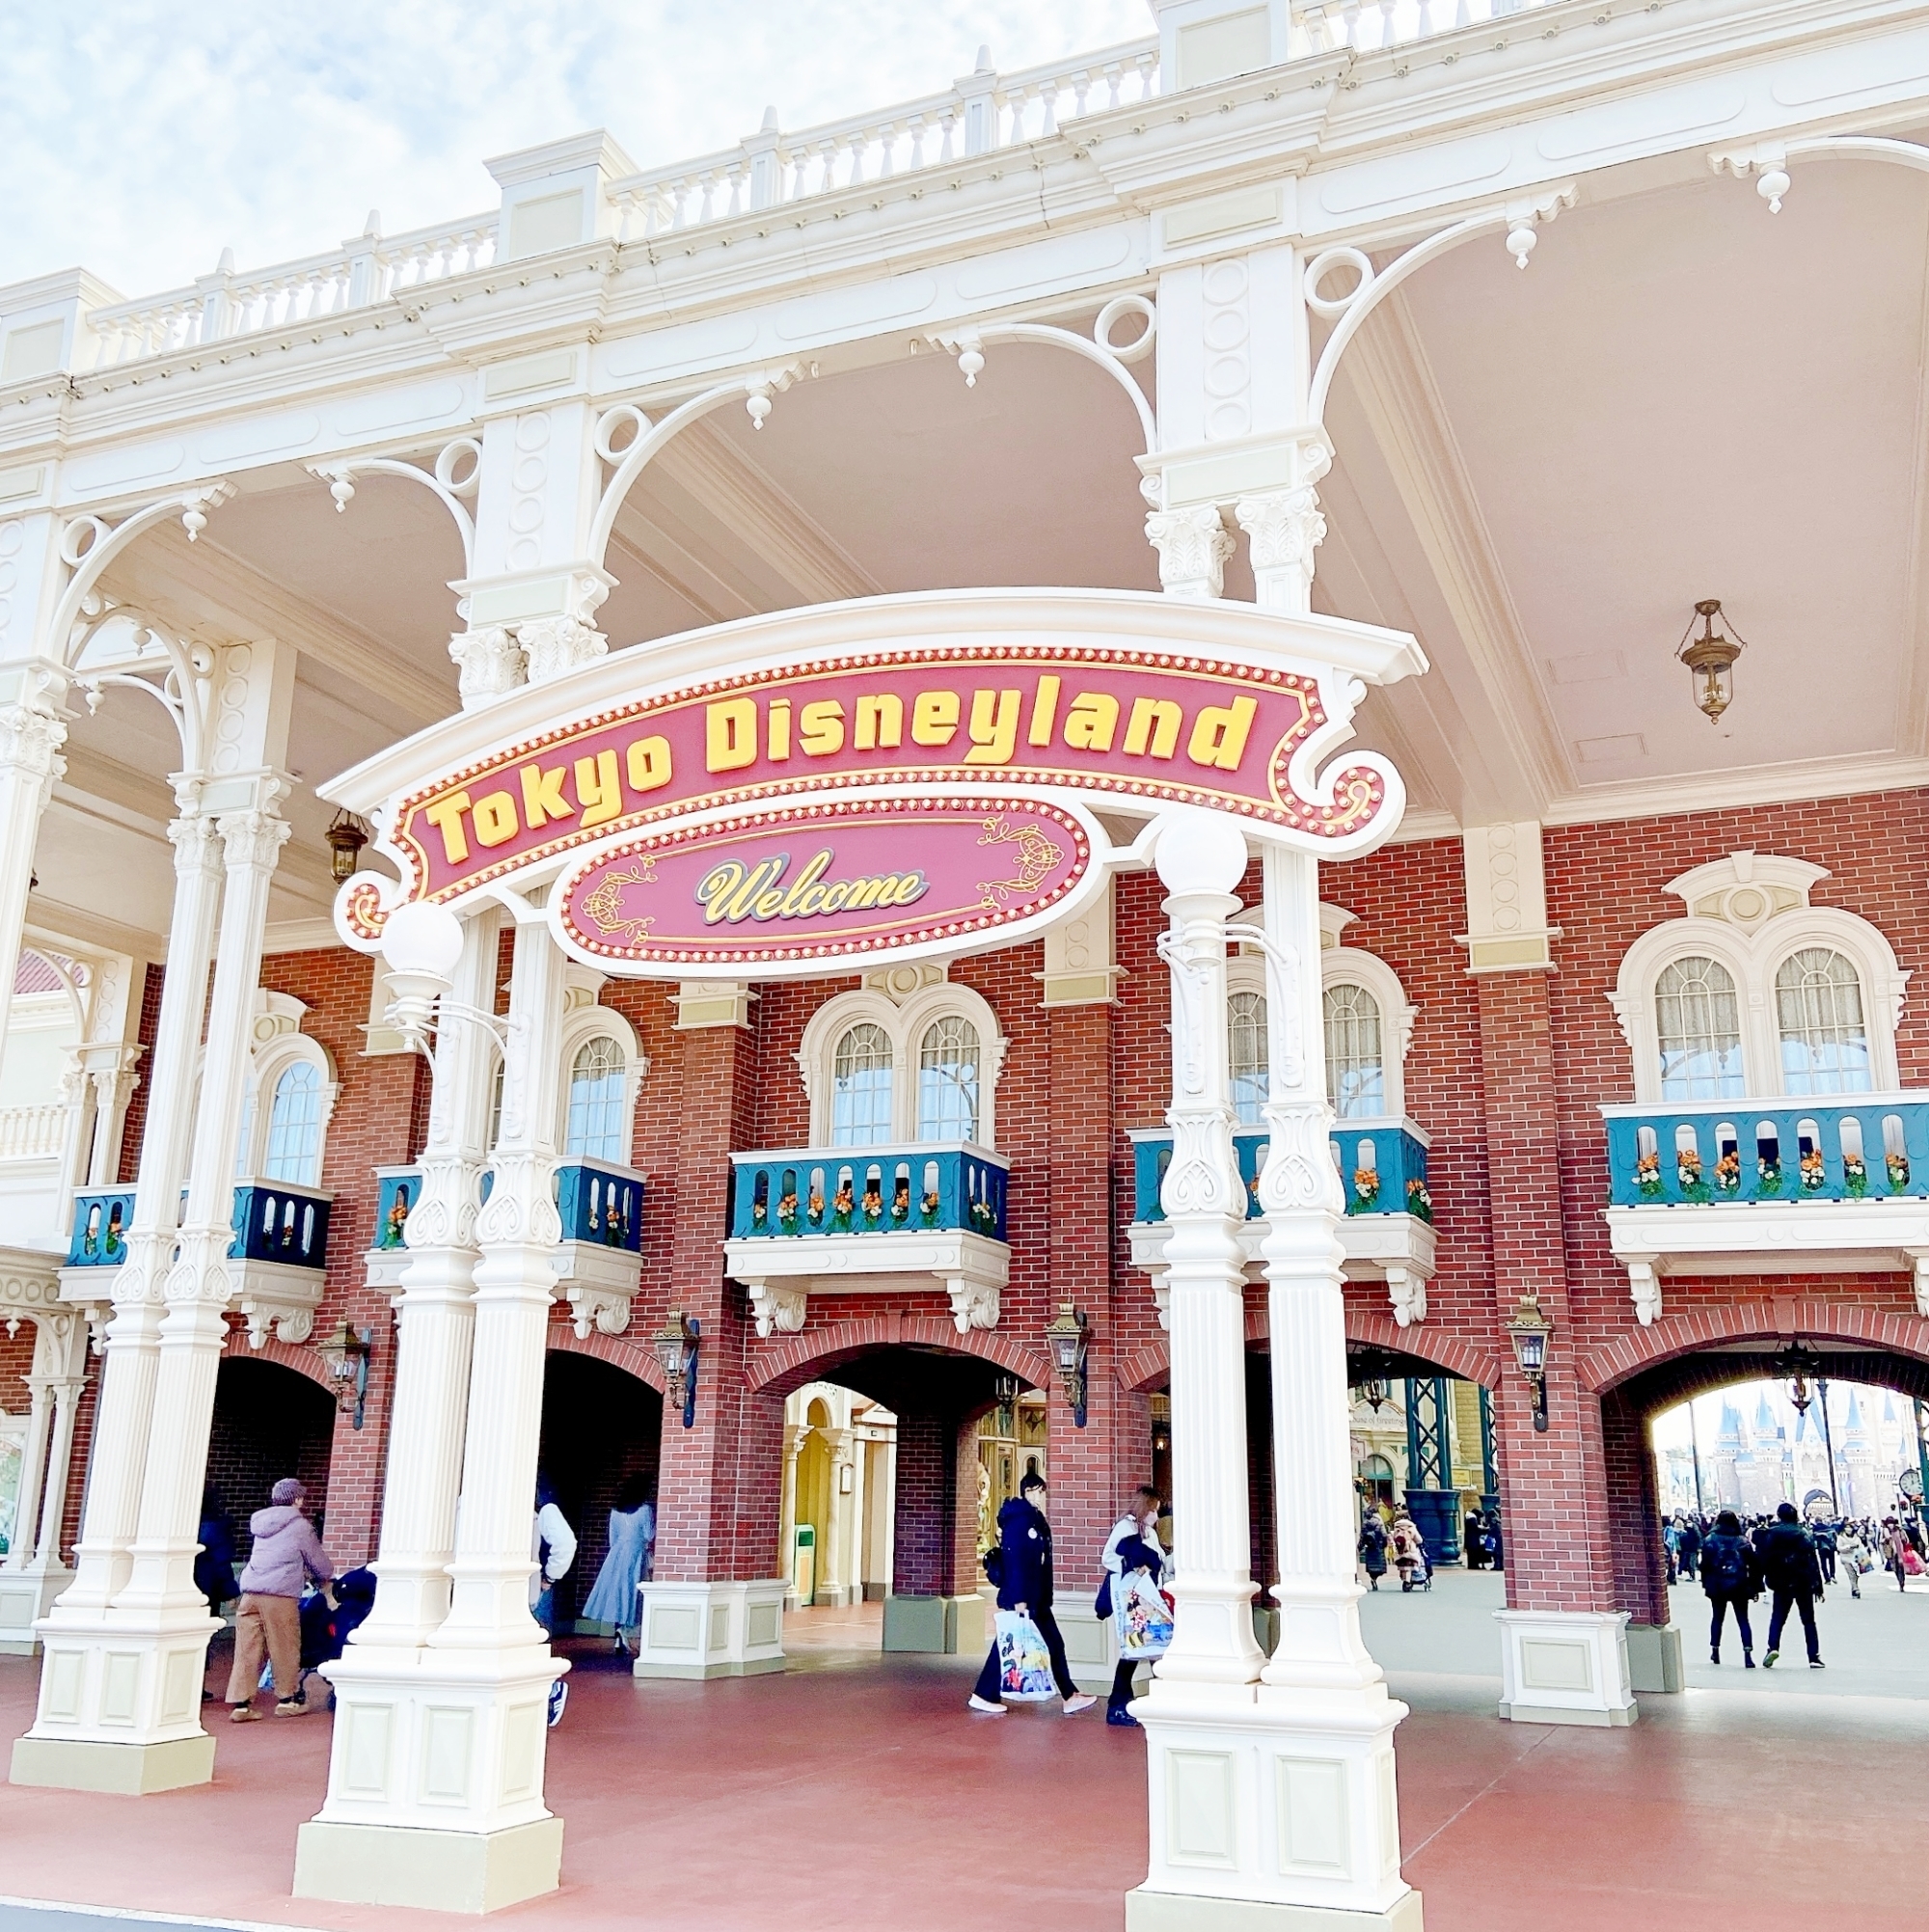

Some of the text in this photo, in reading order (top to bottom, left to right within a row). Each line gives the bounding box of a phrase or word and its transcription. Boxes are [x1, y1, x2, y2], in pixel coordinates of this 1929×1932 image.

[425, 675, 1258, 864] Tokyo Disneyland
[695, 848, 928, 924] Welcome
